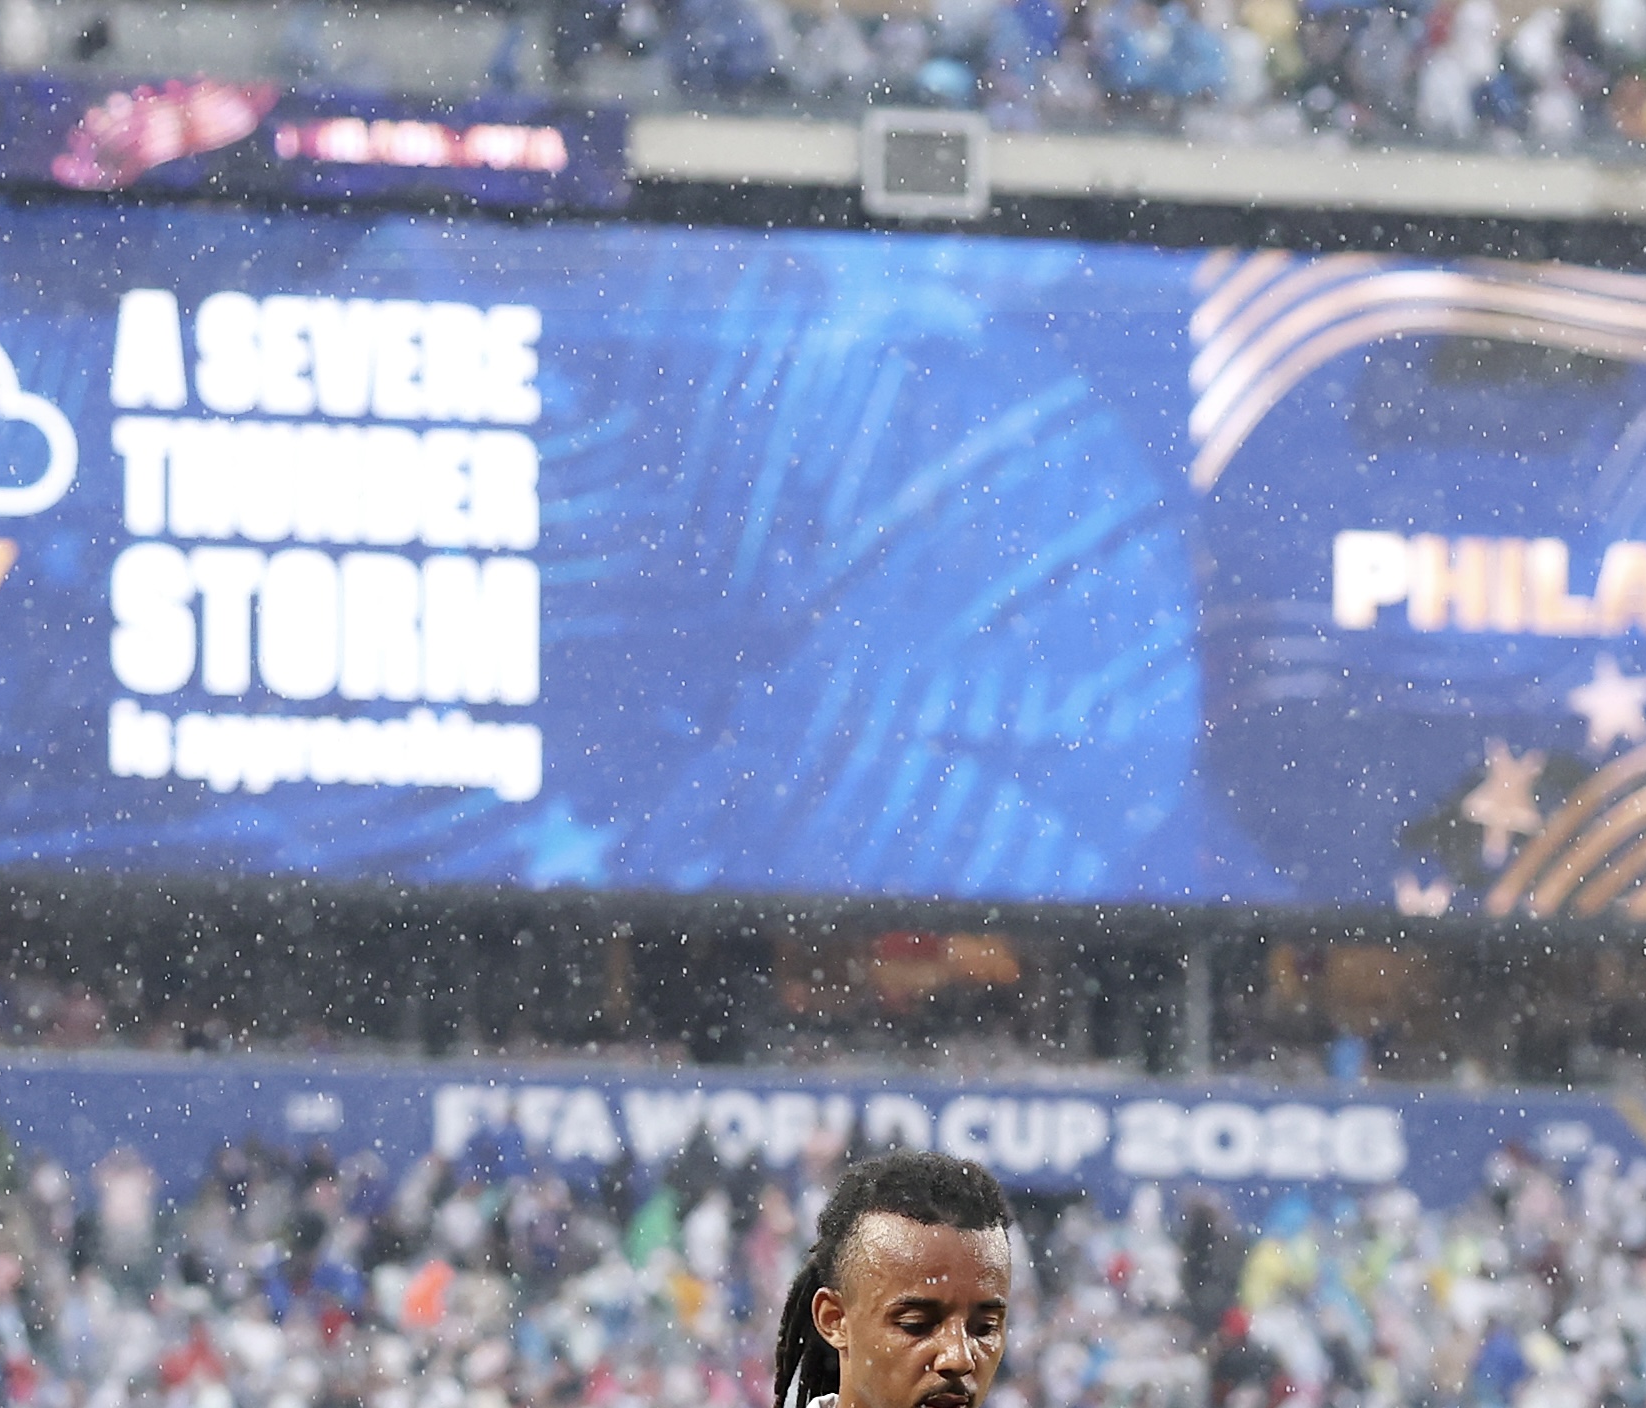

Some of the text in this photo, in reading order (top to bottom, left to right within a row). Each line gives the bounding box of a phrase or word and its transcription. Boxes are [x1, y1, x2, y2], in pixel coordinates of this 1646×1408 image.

[112, 289, 540, 422] A SEVERE
[113, 416, 539, 549] THUNDER
[112, 543, 540, 704] STORM
[940, 1097, 1108, 1174] CUP
[1112, 1101, 1407, 1181] 2026
